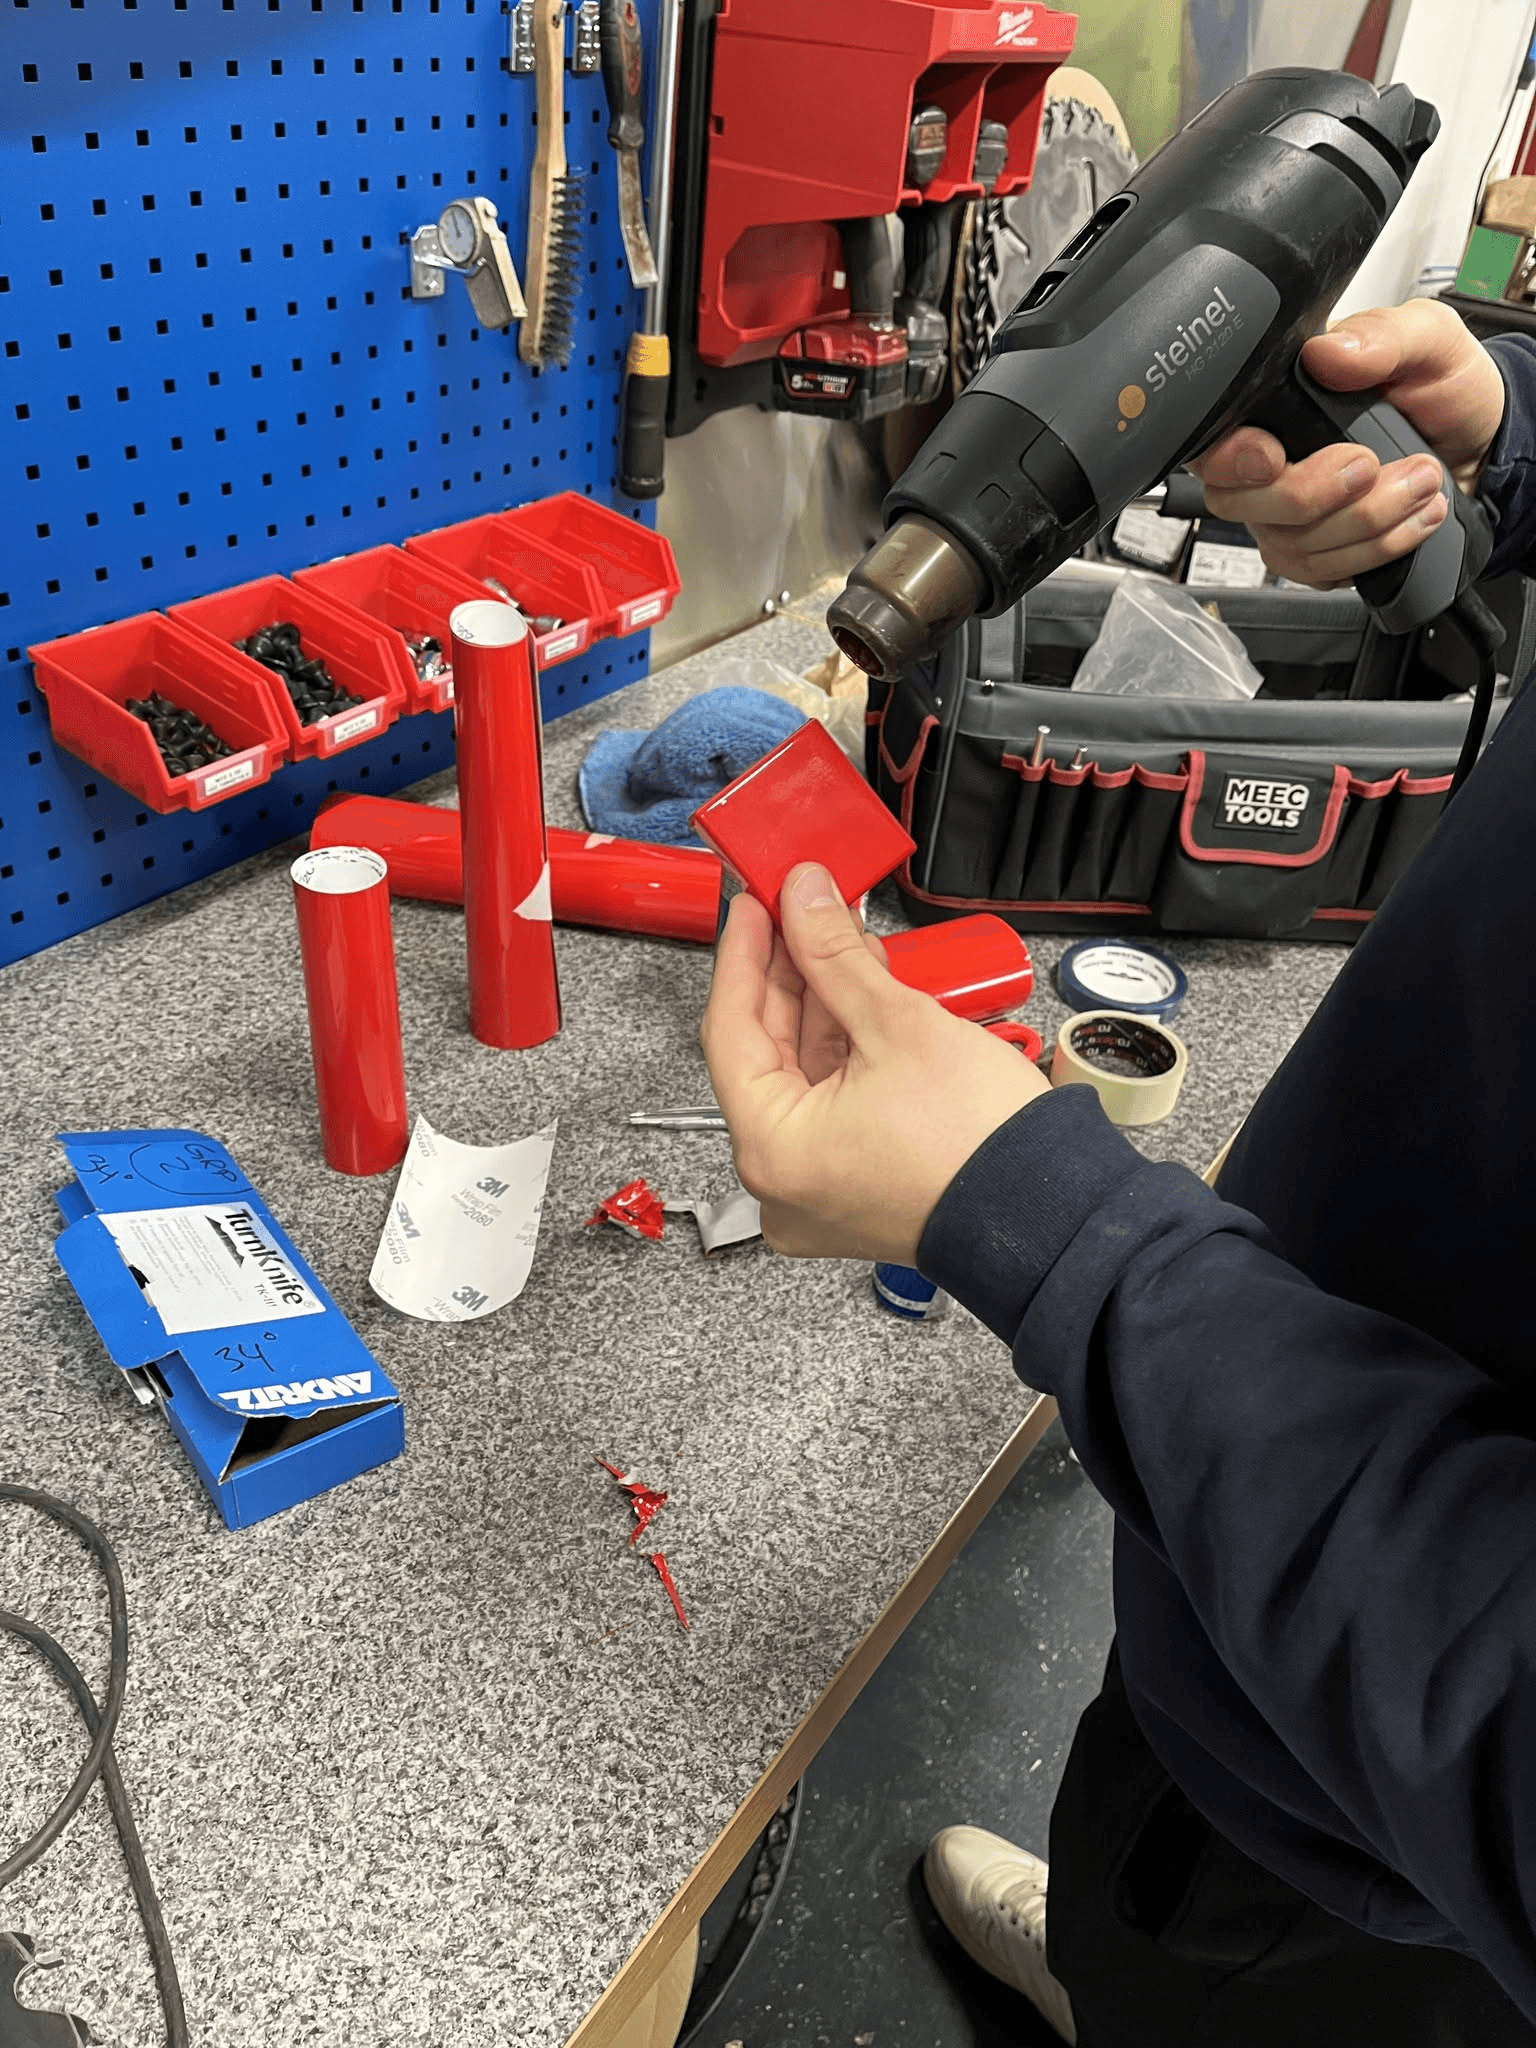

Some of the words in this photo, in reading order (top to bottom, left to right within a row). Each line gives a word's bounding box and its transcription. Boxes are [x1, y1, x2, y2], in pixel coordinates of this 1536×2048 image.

[1145, 286, 1236, 393] steinel
[1228, 782, 1305, 806] MEEC
[1224, 804, 1301, 828] TOOLS
[475, 1176, 511, 1199] 3M
[395, 1200, 422, 1239] 3M
[451, 1285, 490, 1312] 3M
